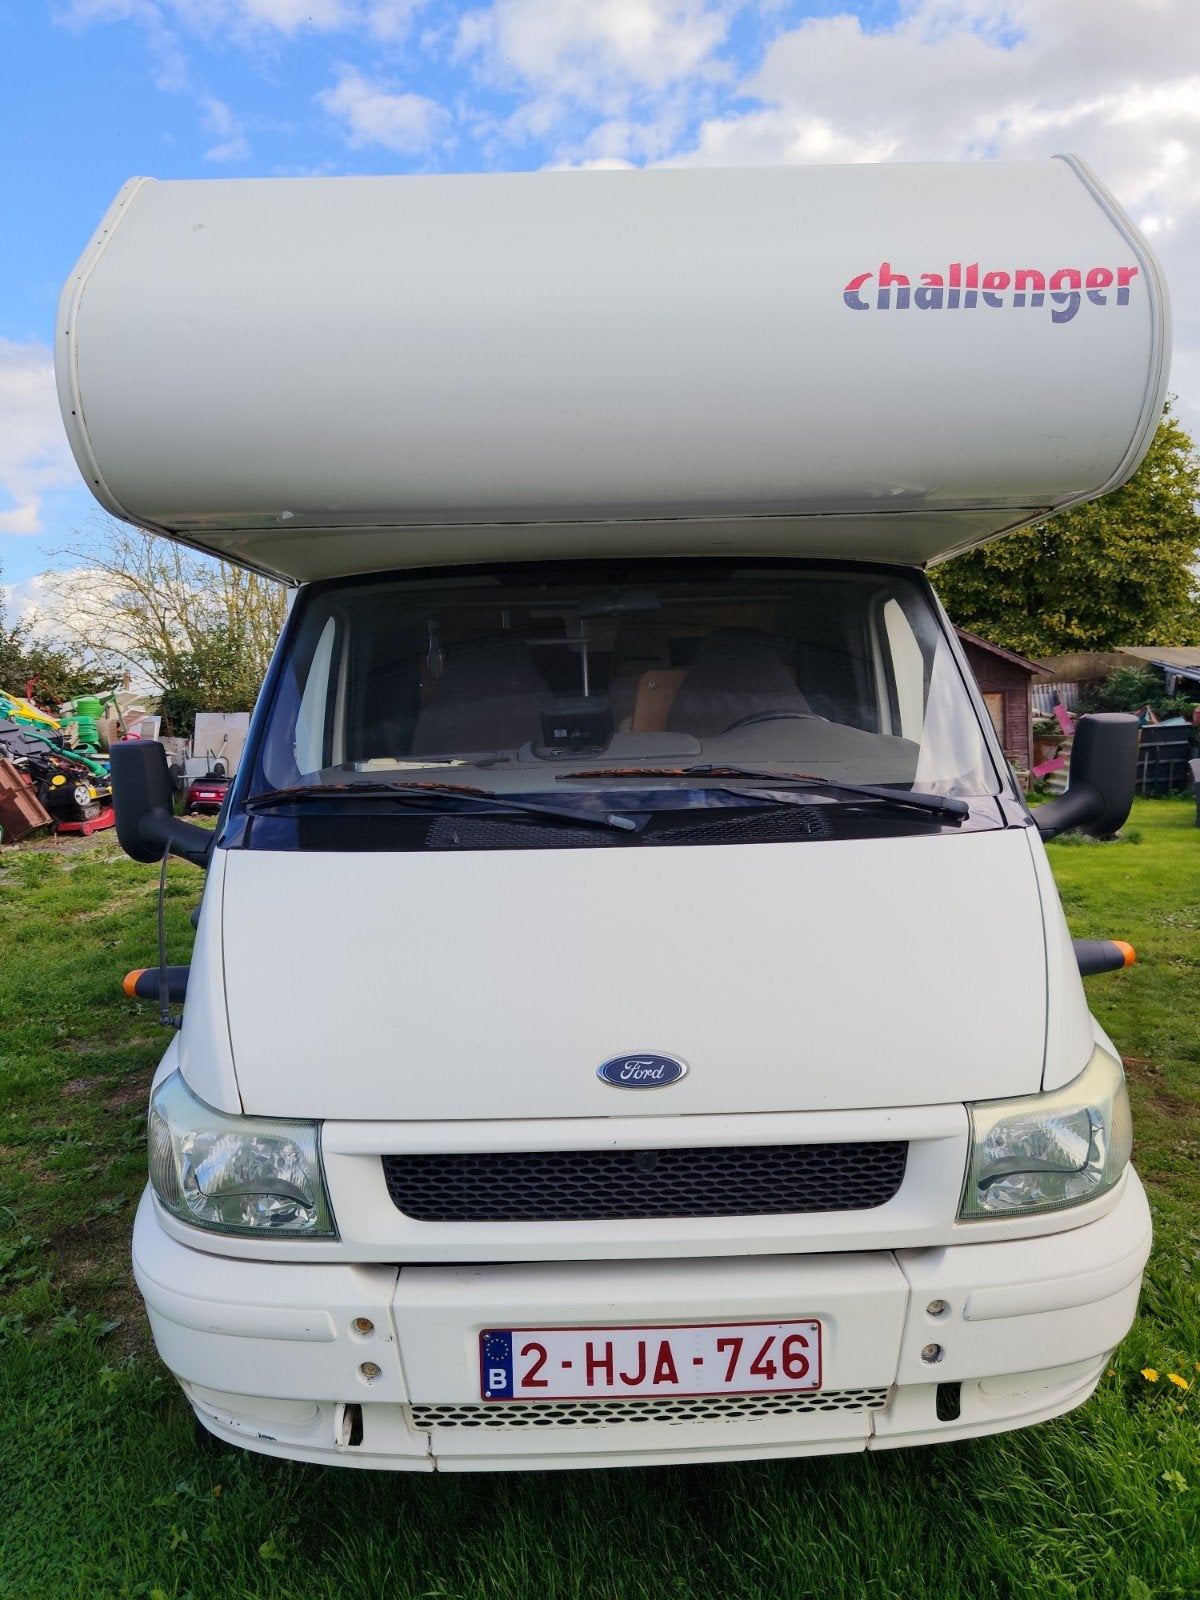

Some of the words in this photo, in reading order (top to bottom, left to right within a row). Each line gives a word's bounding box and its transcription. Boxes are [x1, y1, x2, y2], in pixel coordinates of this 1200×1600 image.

[843, 262, 1138, 324] challenger
[620, 1060, 665, 1080] Ford
[488, 1369, 507, 1390] B
